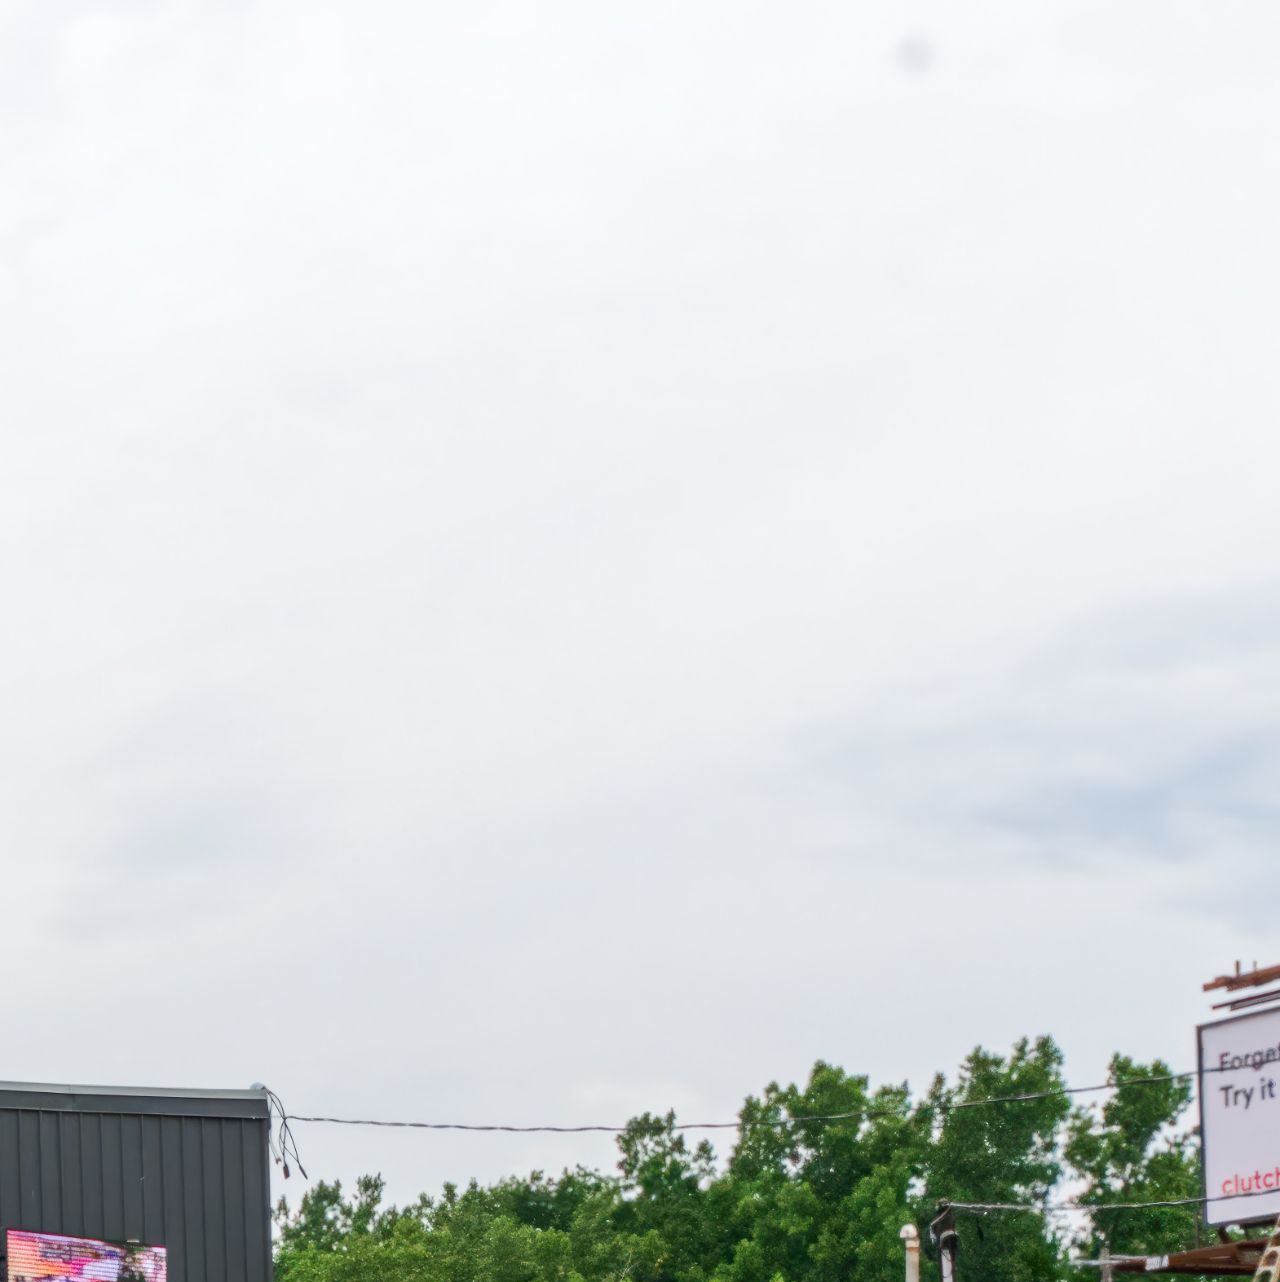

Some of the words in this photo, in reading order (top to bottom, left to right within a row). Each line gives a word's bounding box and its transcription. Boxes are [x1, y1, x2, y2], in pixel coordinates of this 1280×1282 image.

[1219, 1041, 1280, 1071] Forge
[1220, 1085, 1254, 1109] Try
[1260, 1077, 1275, 1100] it
